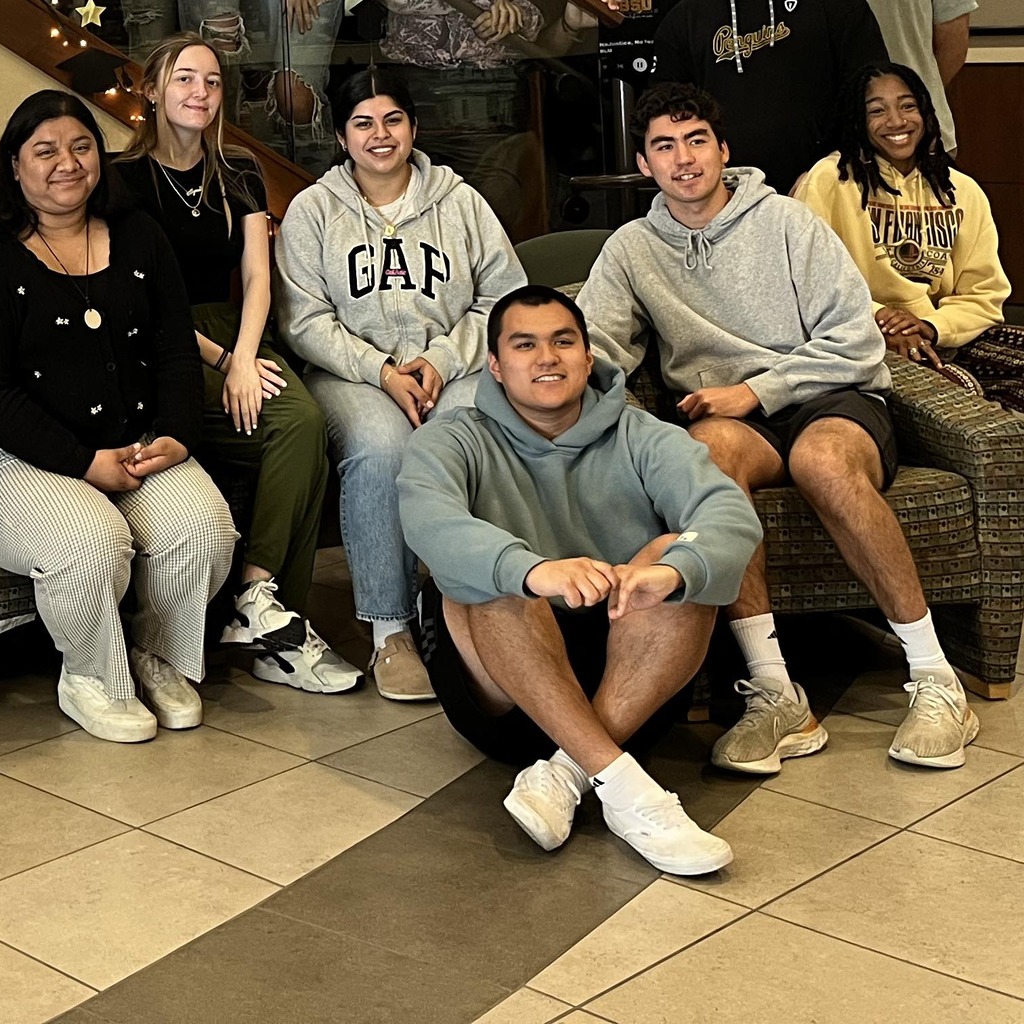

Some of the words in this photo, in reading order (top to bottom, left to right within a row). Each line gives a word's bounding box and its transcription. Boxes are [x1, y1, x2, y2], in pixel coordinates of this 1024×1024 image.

[713, 21, 790, 62] Penguins
[347, 237, 451, 301] GAP
[926, 250, 948, 260] COA
